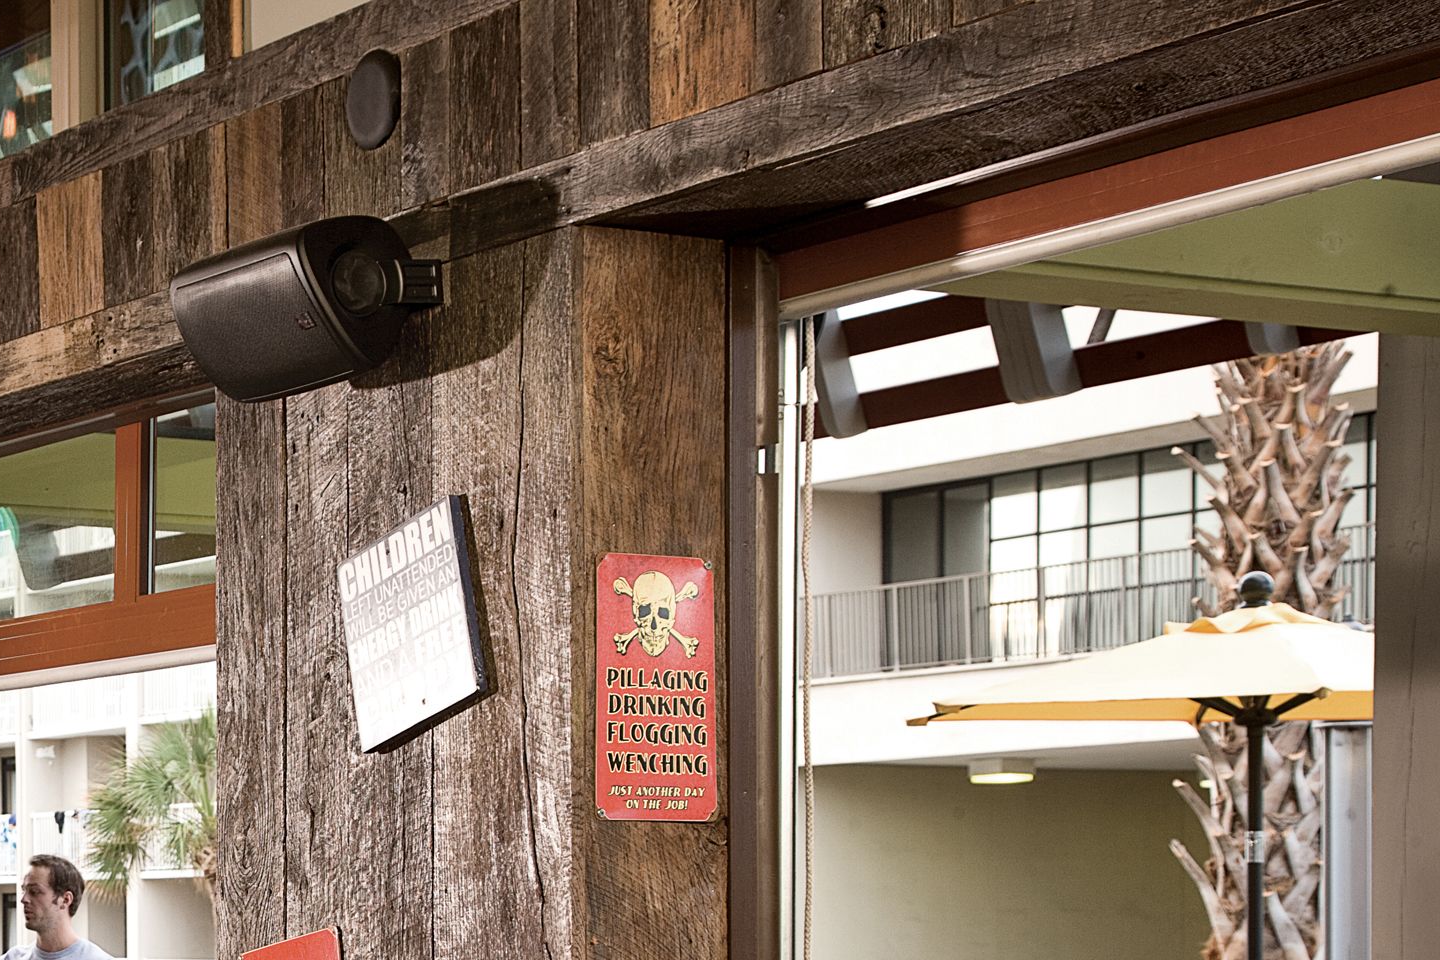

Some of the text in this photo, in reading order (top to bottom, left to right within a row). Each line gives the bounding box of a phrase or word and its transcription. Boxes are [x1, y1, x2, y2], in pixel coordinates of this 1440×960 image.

[339, 500, 451, 602] CHILDREN
[344, 543, 454, 623] LEFT UNATTENDED
[345, 565, 456, 642] WILL BE GIVEN AN
[348, 582, 461, 674] ENERGY DRINK
[359, 617, 467, 692] AND A FREE
[606, 667, 708, 693] PILLAGING
[608, 693, 706, 719] DRINKING
[607, 721, 708, 748] FLOGGING
[607, 750, 708, 776] WENCHING
[608, 785, 706, 798] JUST ANOTHER DAY
[626, 799, 688, 811] ON THE JOB!
